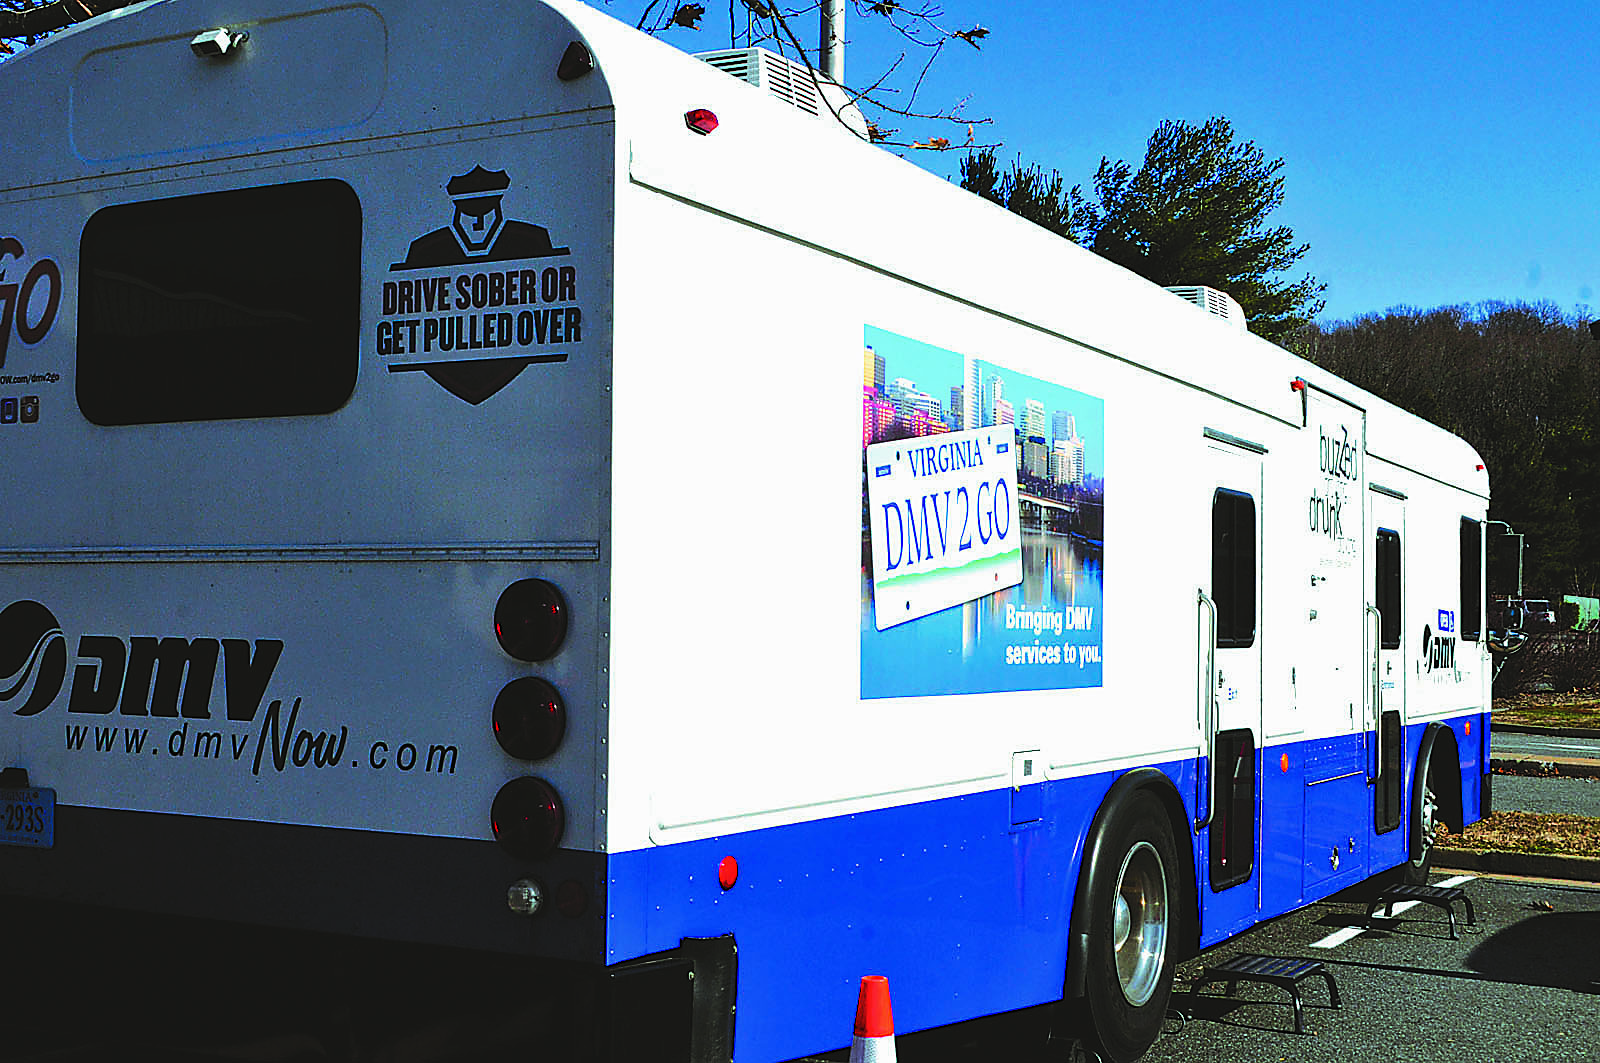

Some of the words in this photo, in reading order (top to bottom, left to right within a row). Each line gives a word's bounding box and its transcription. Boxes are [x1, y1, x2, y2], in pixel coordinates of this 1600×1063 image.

[383, 277, 450, 316] DRIVE
[455, 270, 536, 310] SOBER
[541, 265, 576, 303] OR
[376, 319, 420, 356] GET
[423, 312, 513, 352] PULLED
[516, 307, 582, 346] OVER
[907, 438, 984, 478] VIRGINIA
[1308, 487, 1343, 541] drunk
[1005, 604, 1063, 636] Bringing
[1065, 606, 1094, 631] DMV
[1005, 641, 1061, 666] services
[1063, 645, 1076, 664] to
[1078, 647, 1102, 669] you.
[65, 697, 459, 776] www.dmvNow.com
